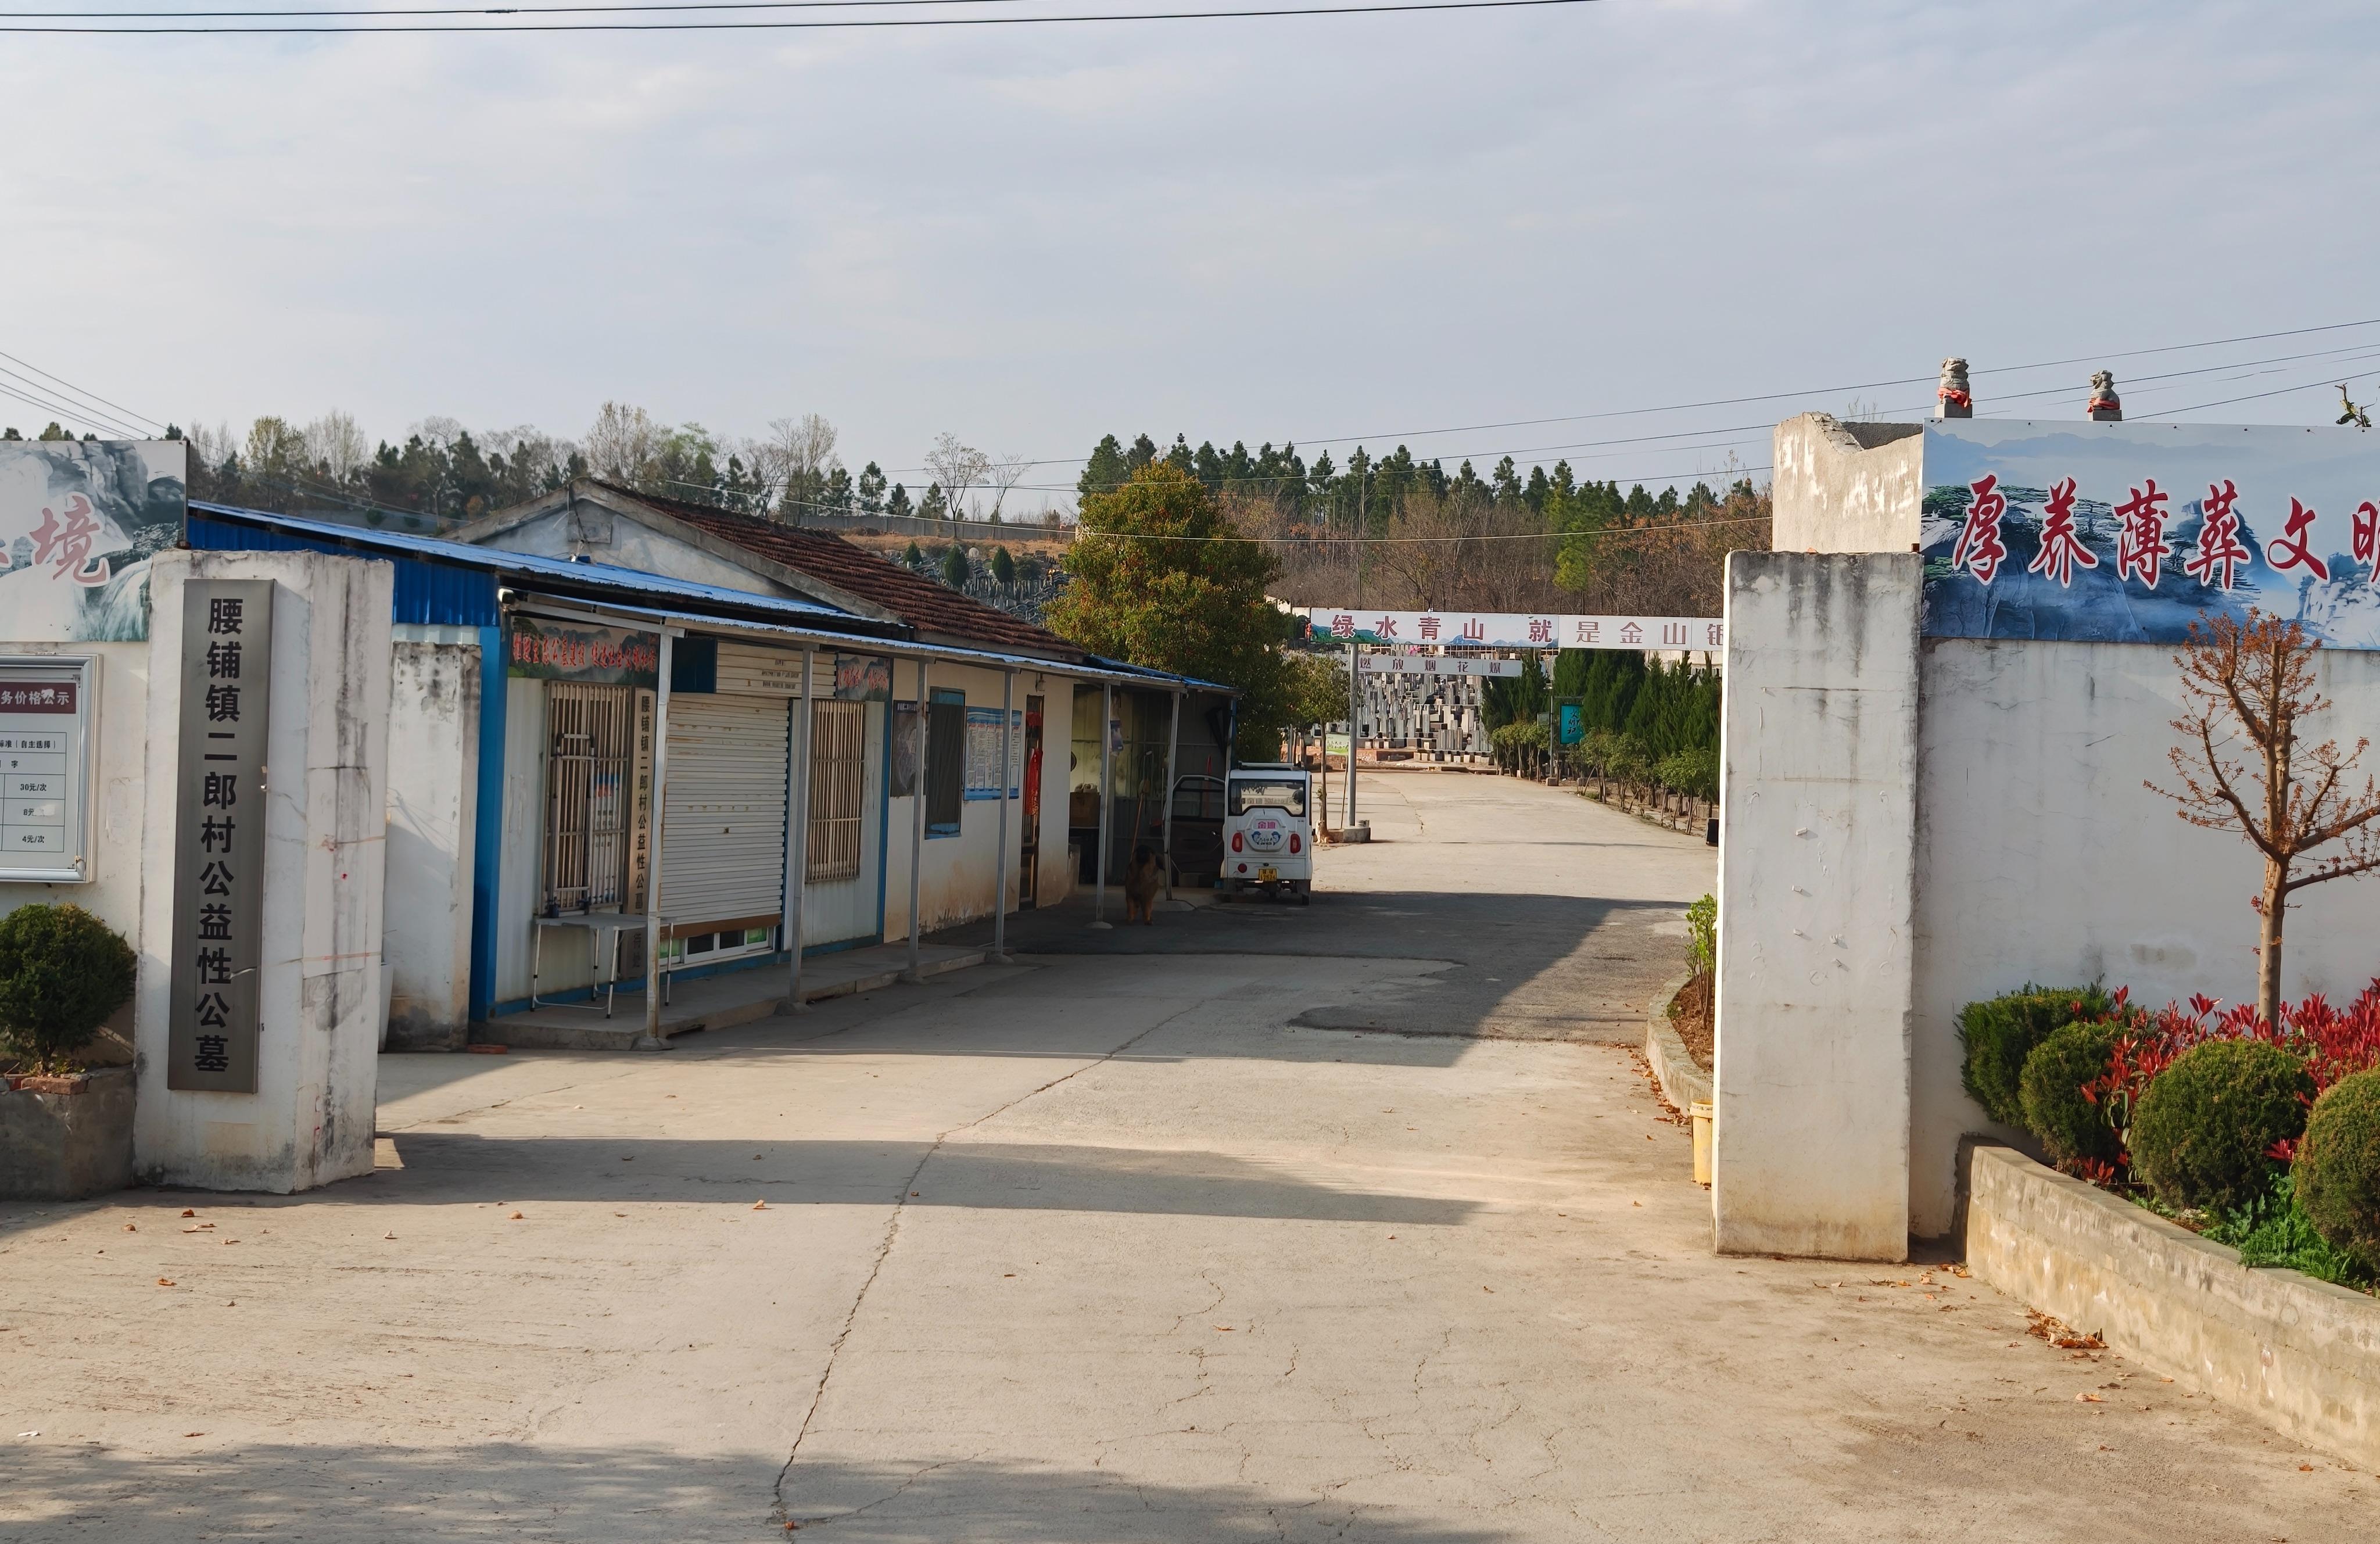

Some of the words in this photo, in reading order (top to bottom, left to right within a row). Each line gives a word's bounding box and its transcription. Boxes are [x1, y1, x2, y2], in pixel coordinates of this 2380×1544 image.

[0, 496, 107, 583] 境
[1954, 474, 2380, 589] 厚养薄葬文明
[1331, 615, 1484, 640] 绿水青山
[1529, 619, 1723, 646] 就是金山银
[1, 690, 70, 705] 务价格公示
[22, 835, 45, 843] 4元/次
[195, 599, 243, 1072] 腰铺镇二郎村公益性公墓
